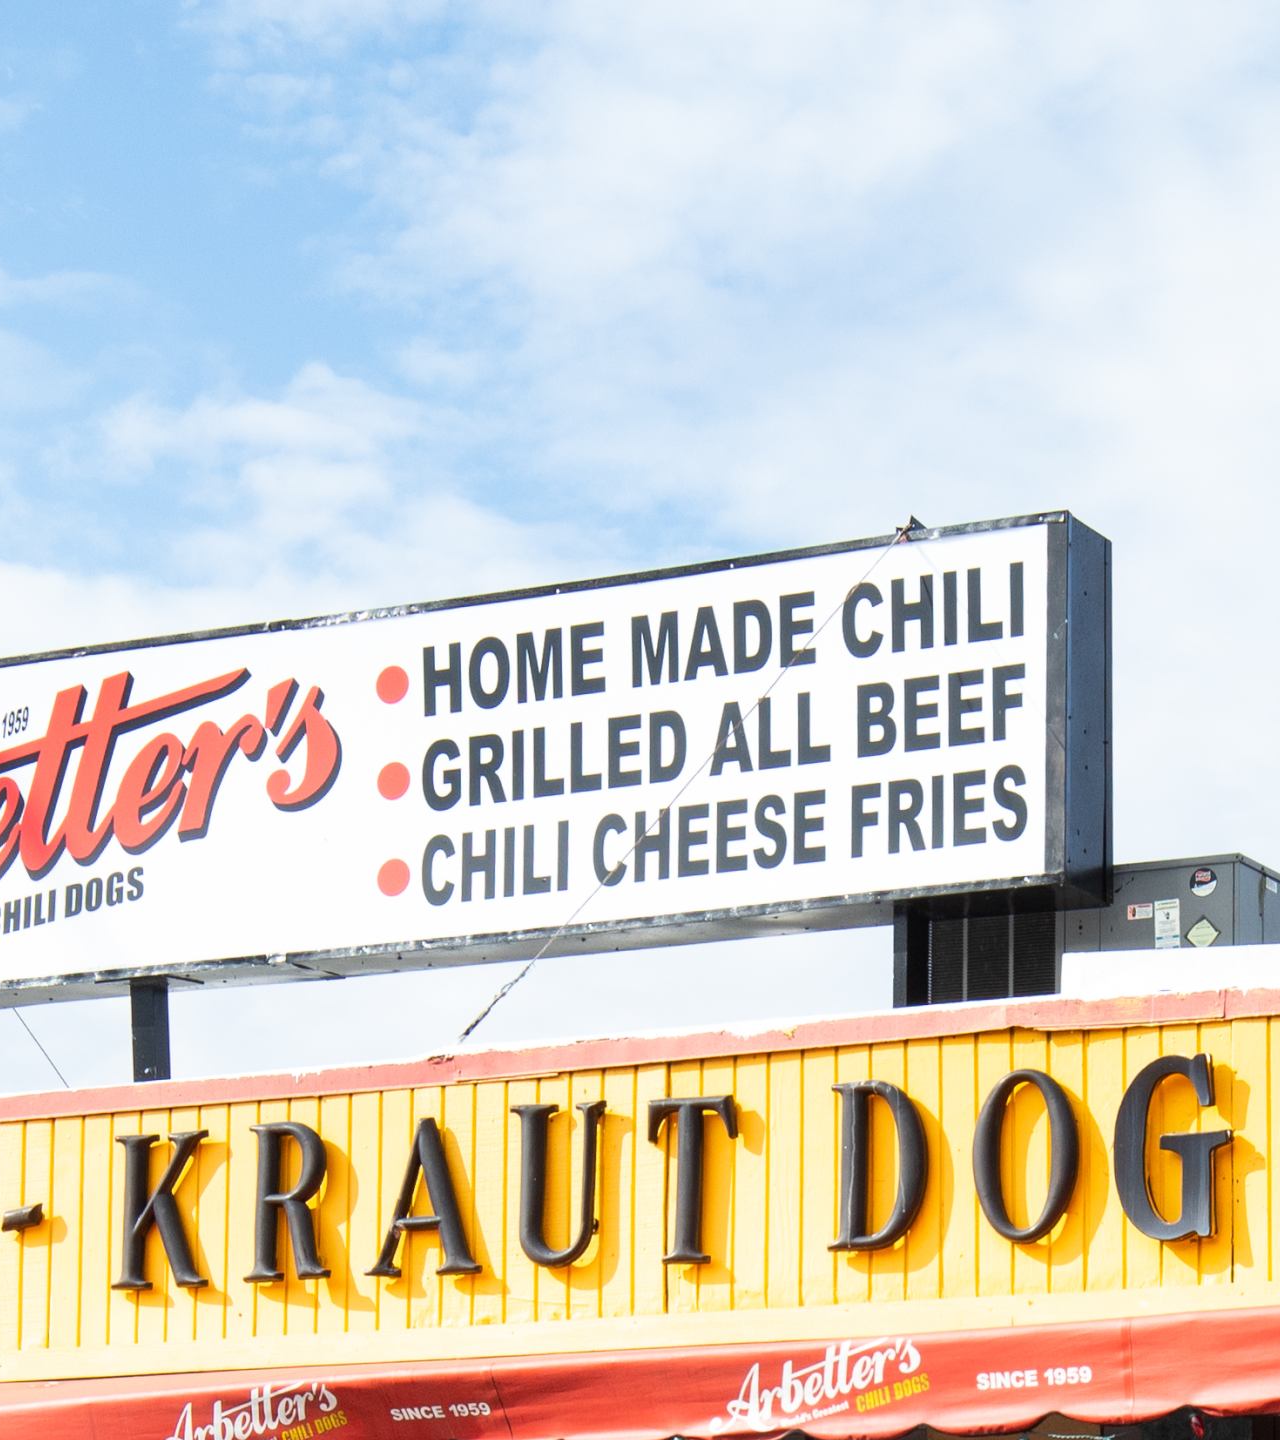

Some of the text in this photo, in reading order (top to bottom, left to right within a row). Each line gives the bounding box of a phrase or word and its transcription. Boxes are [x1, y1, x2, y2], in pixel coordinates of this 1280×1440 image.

[422, 560, 1025, 718] HOME MADE CHILI
[1, 706, 30, 737] 1959
[421, 663, 1027, 812] GRILLED ALL BEEF
[421, 763, 1029, 907] CHILI CHEESE FRIES
[63, 865, 145, 919] DOGS
[1, 1202, 44, 1233] -
[110, 1093, 743, 1293] KRAUT
[826, 1051, 1234, 1254] DOG
[709, 1336, 921, 1432] Arbetter's
[855, 1386, 892, 1413] CHILI
[895, 1373, 930, 1399] DOGS
[976, 1366, 1092, 1391] SINCE 1959
[316, 1410, 348, 1435] DOGS
[390, 1401, 491, 1422] SINCE 1959
